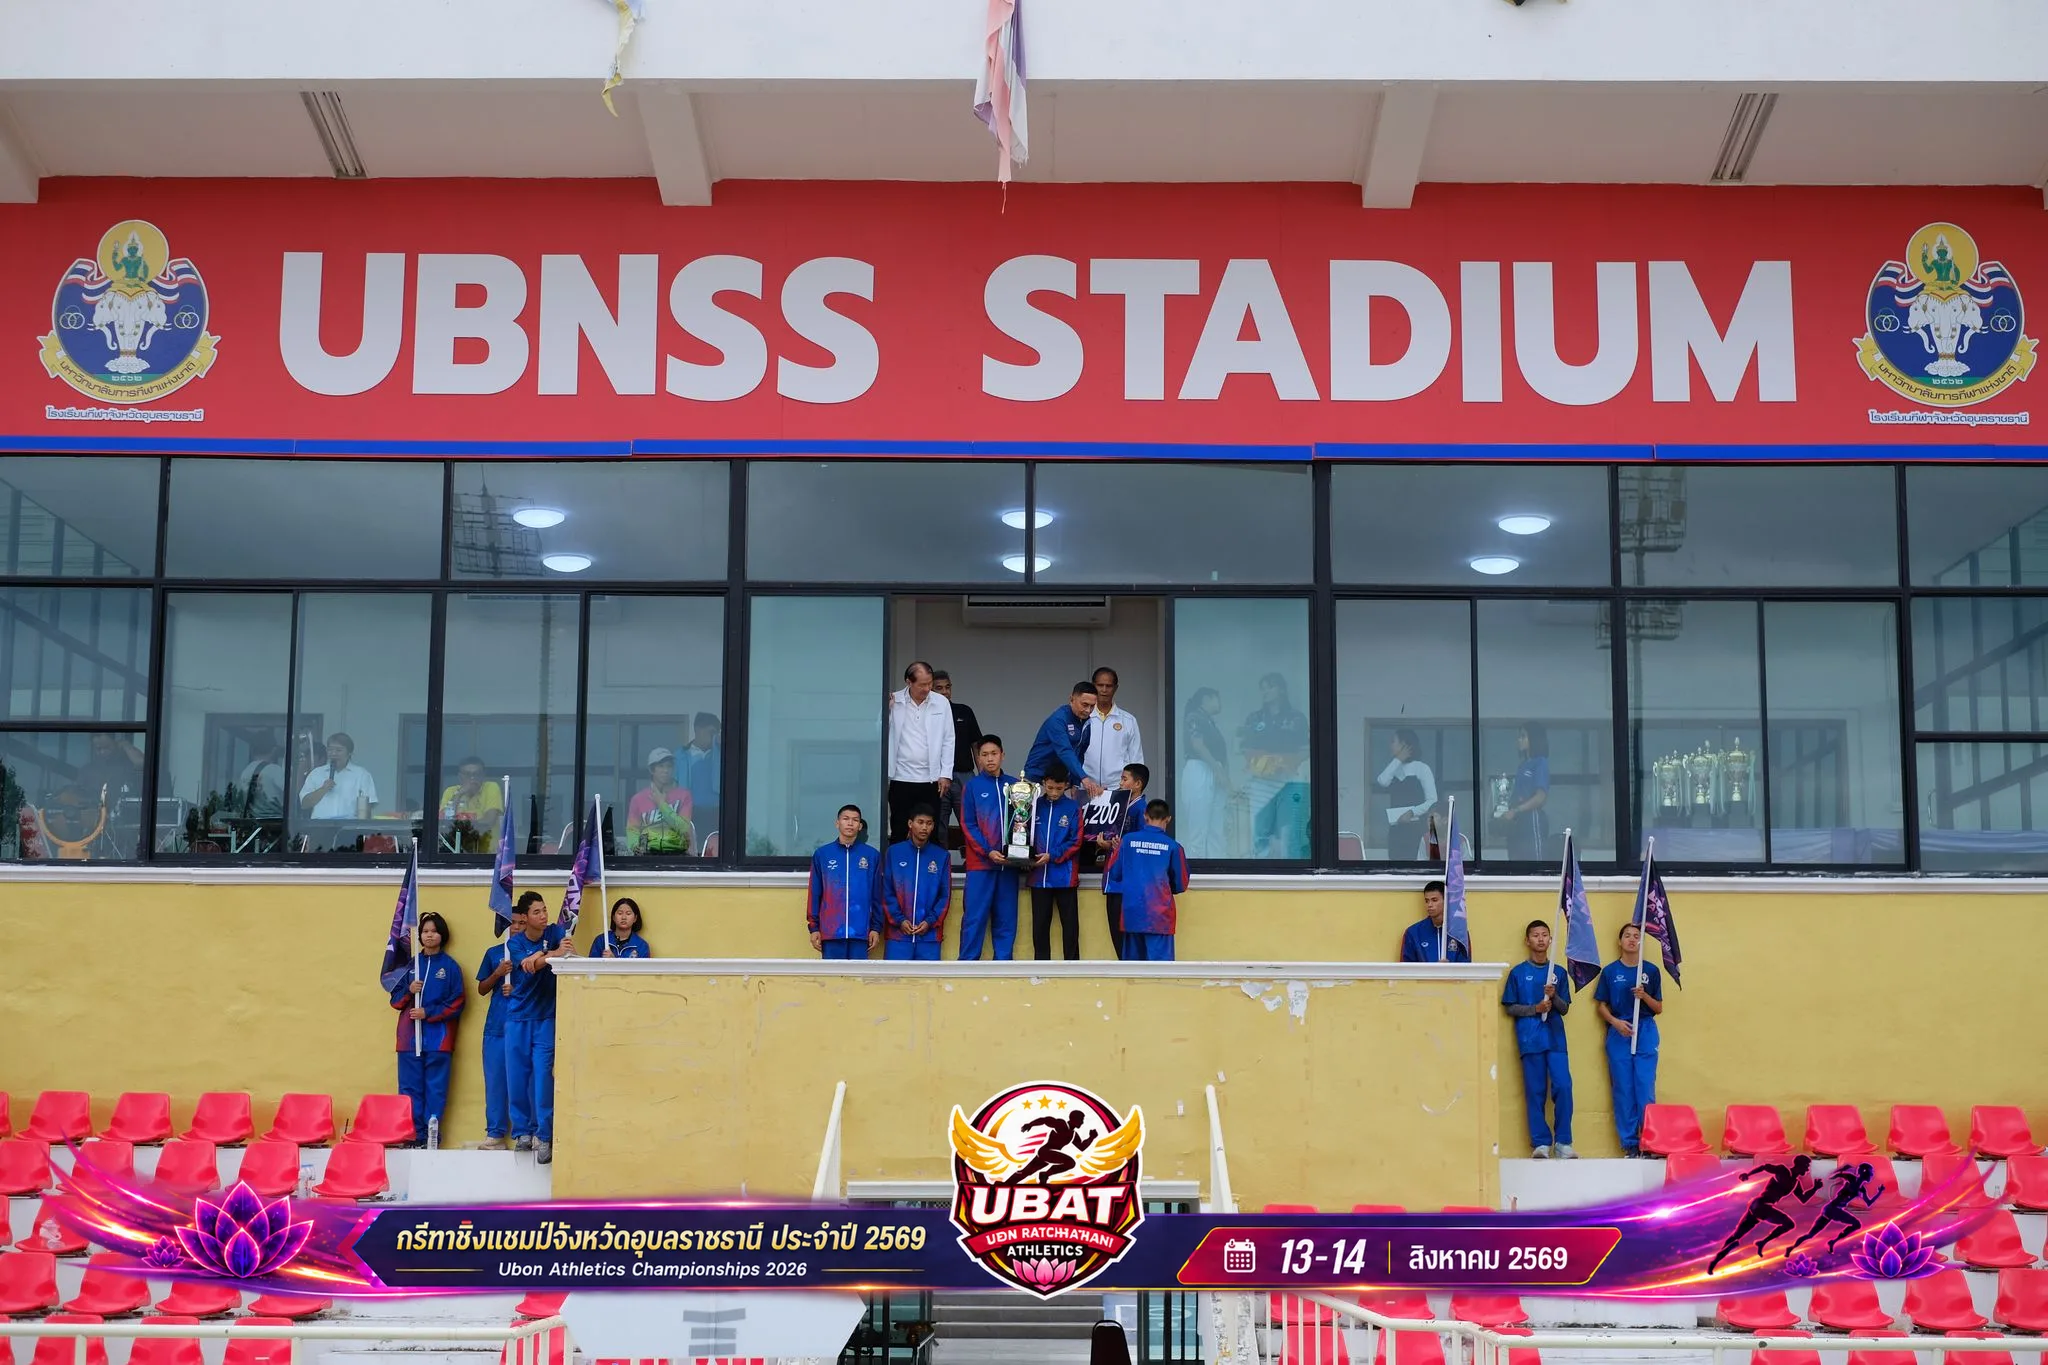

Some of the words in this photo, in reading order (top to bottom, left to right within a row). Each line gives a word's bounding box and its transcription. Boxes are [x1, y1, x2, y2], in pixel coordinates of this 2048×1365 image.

[280, 252, 879, 403] UBNSS
[982, 255, 1797, 405] STADIUM
[60, 361, 196, 398] มหาวิทยาลัยการกีฬาแห่งชาติ
[1878, 364, 2017, 400] มหาวิทยาลัยการกีฬาแห่งชาติ
